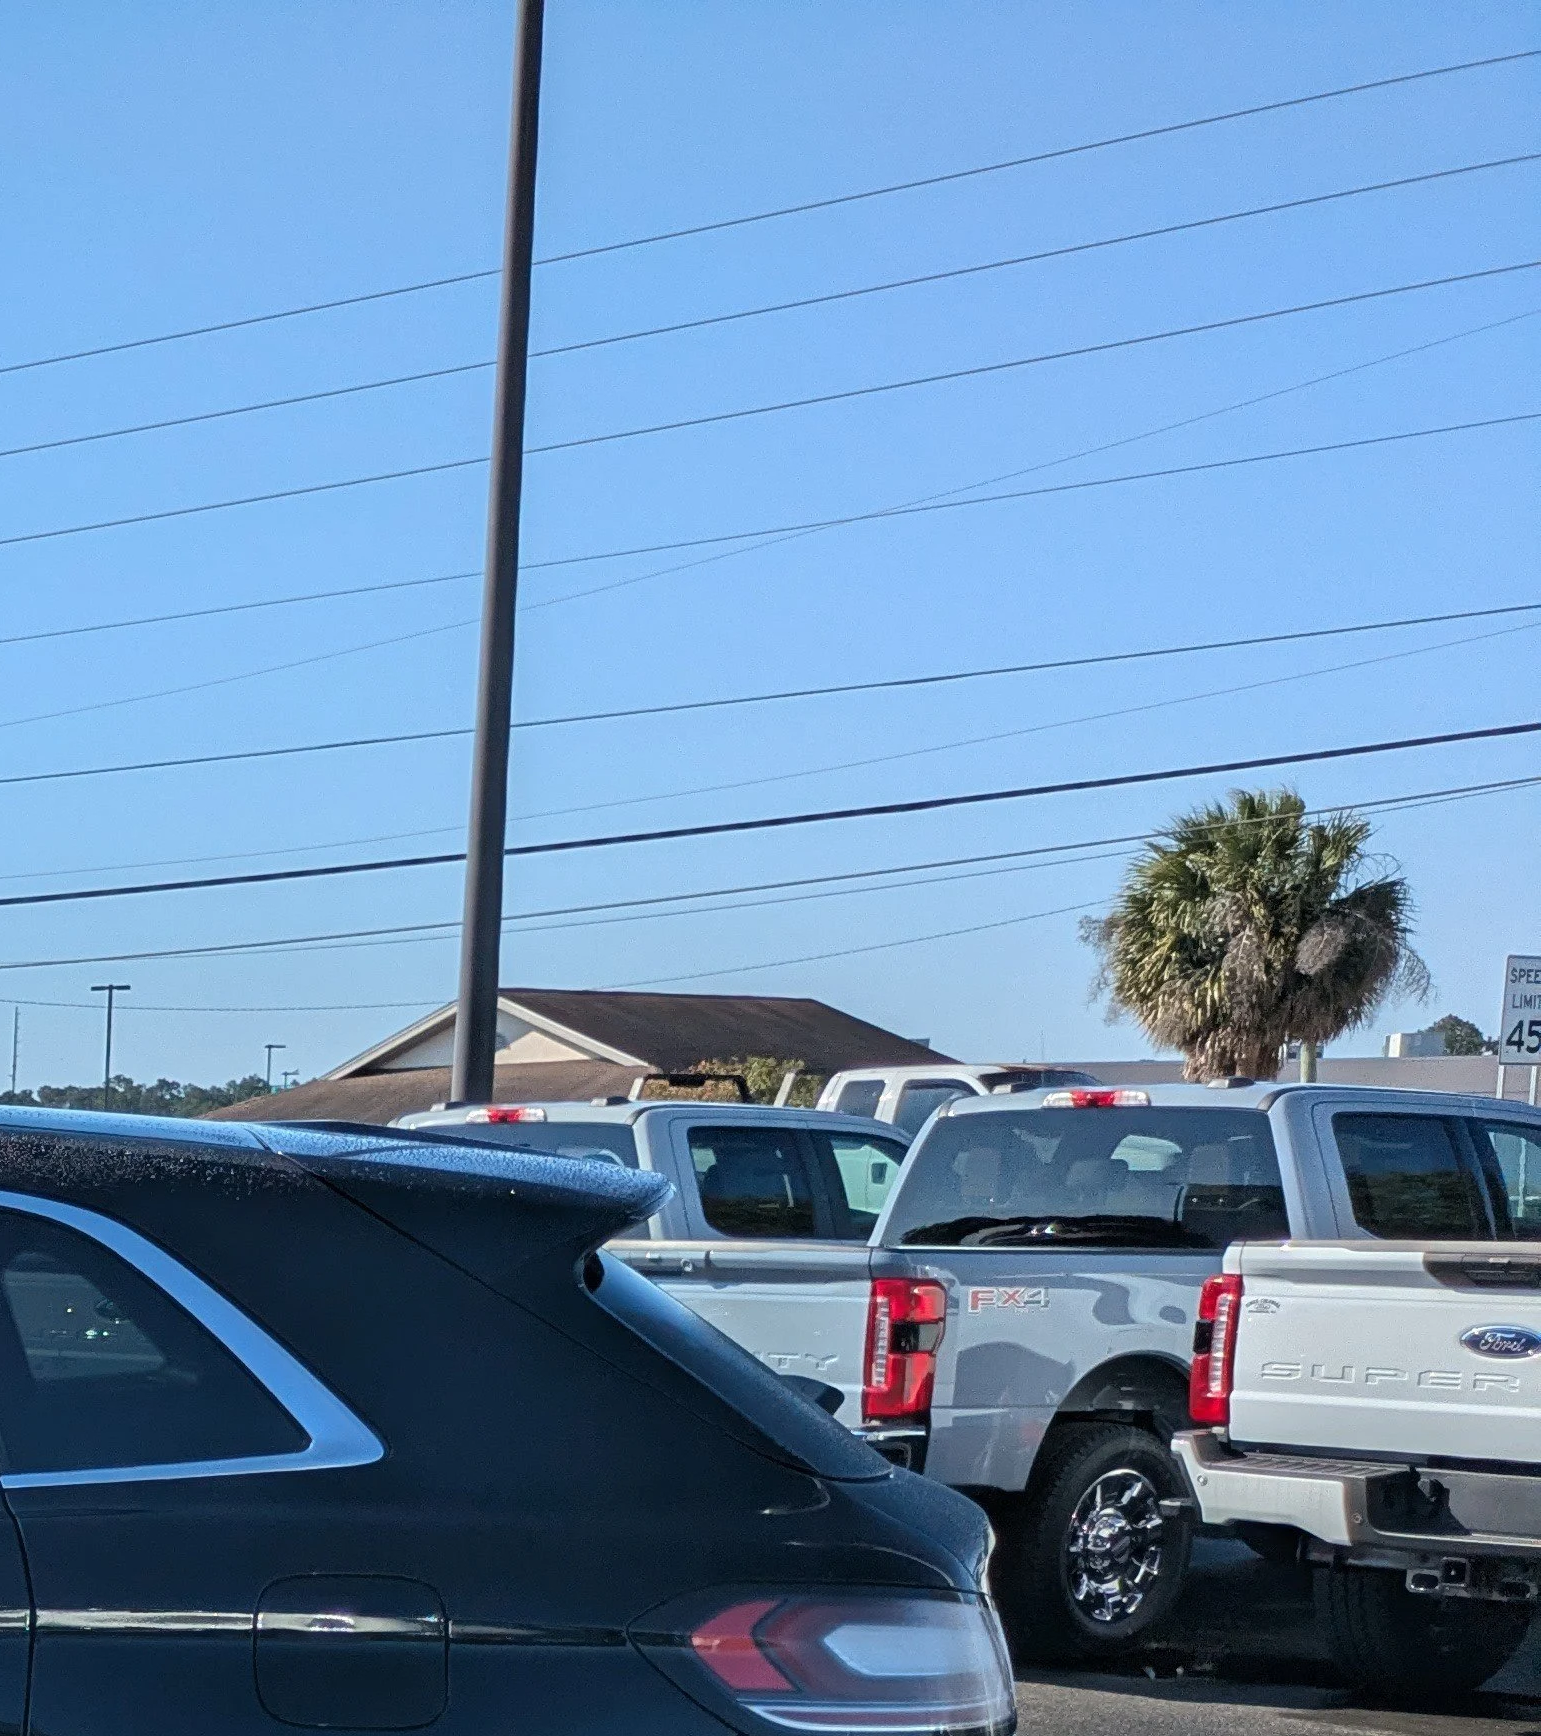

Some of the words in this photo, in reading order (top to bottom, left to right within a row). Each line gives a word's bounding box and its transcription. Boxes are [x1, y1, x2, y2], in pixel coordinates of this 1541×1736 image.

[1505, 1019, 1541, 1053] 45
[968, 1287, 1050, 1314] FX4
[1479, 1332, 1525, 1352] Ford
[1261, 1361, 1520, 1392] SUPER
